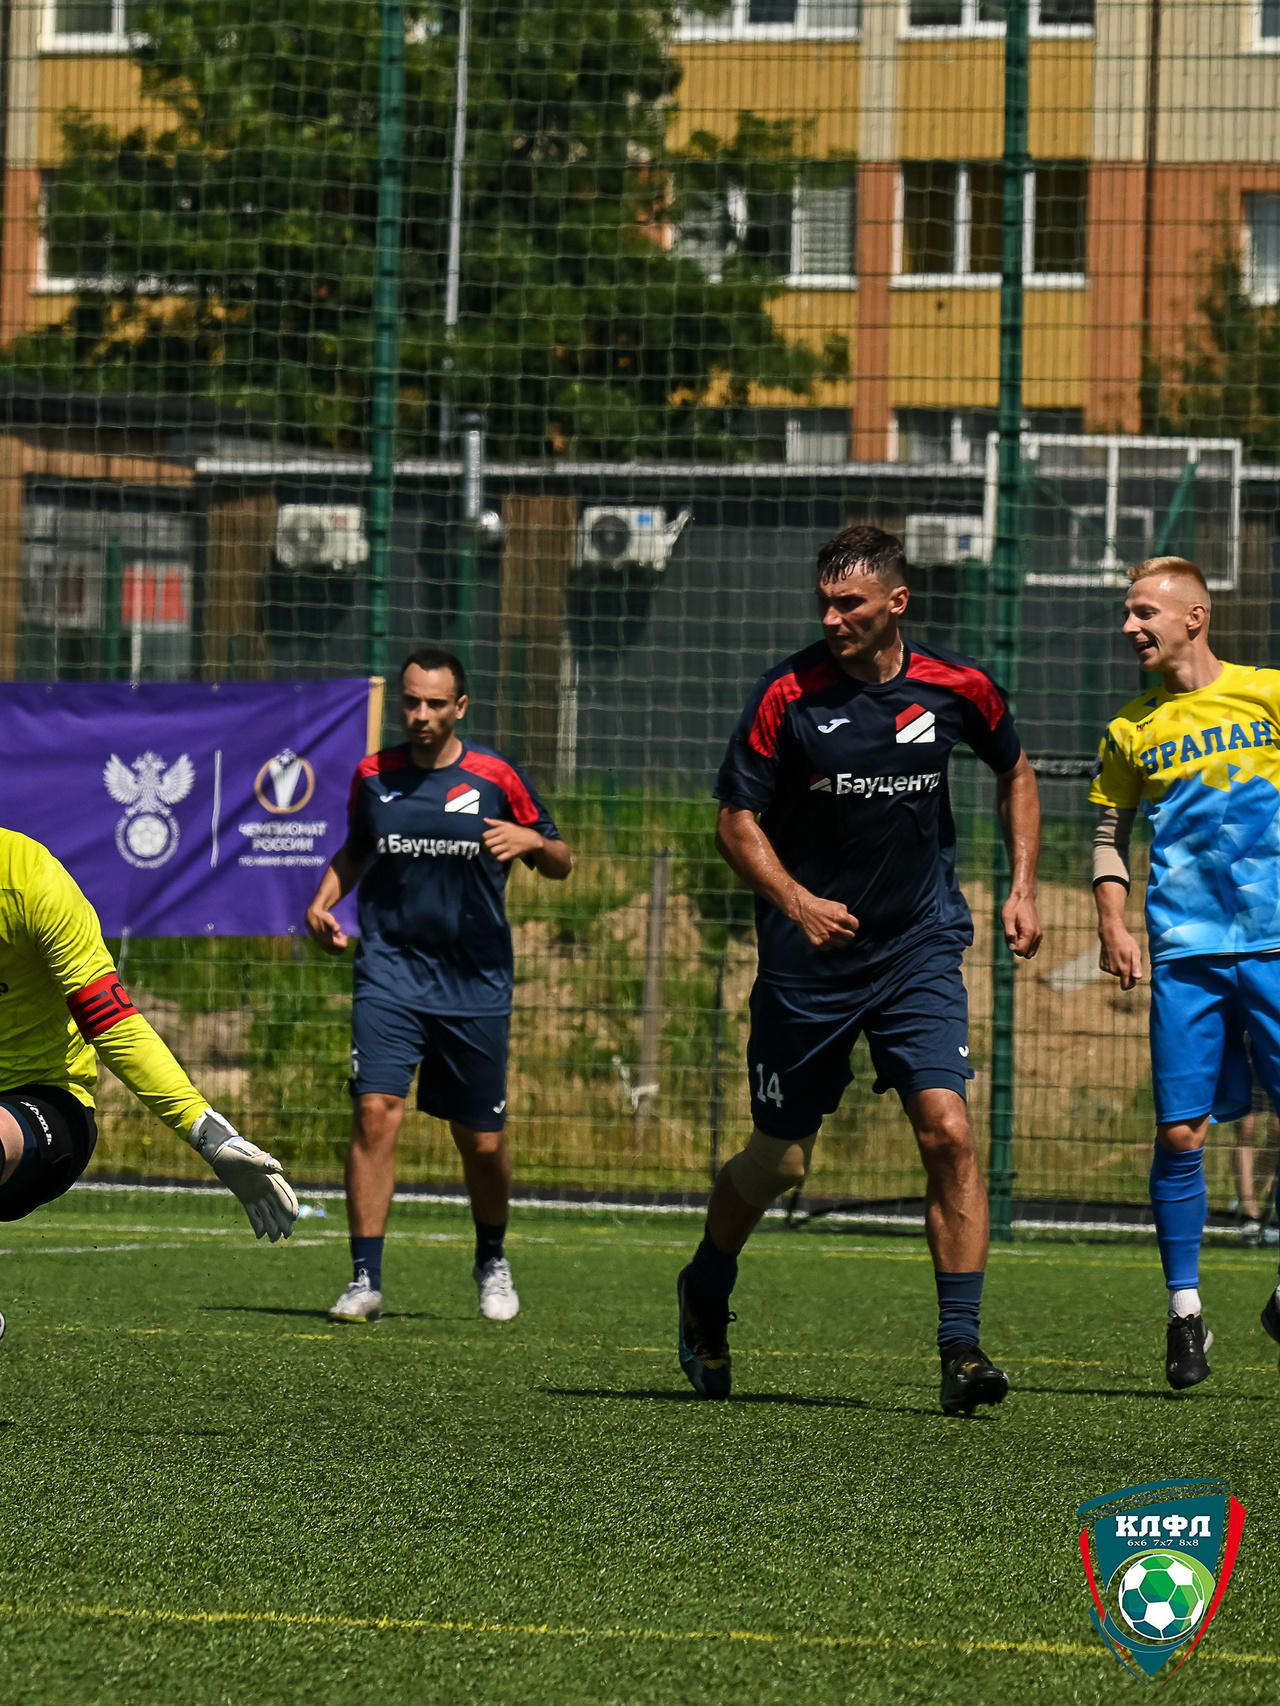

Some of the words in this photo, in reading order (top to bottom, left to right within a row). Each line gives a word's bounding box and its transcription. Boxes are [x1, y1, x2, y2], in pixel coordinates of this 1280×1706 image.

[1140, 720, 1273, 775] УРАЛАН
[836, 772, 941, 799] Бауцентр
[387, 833, 480, 860] Бауцентр
[756, 1063, 784, 1109] 14
